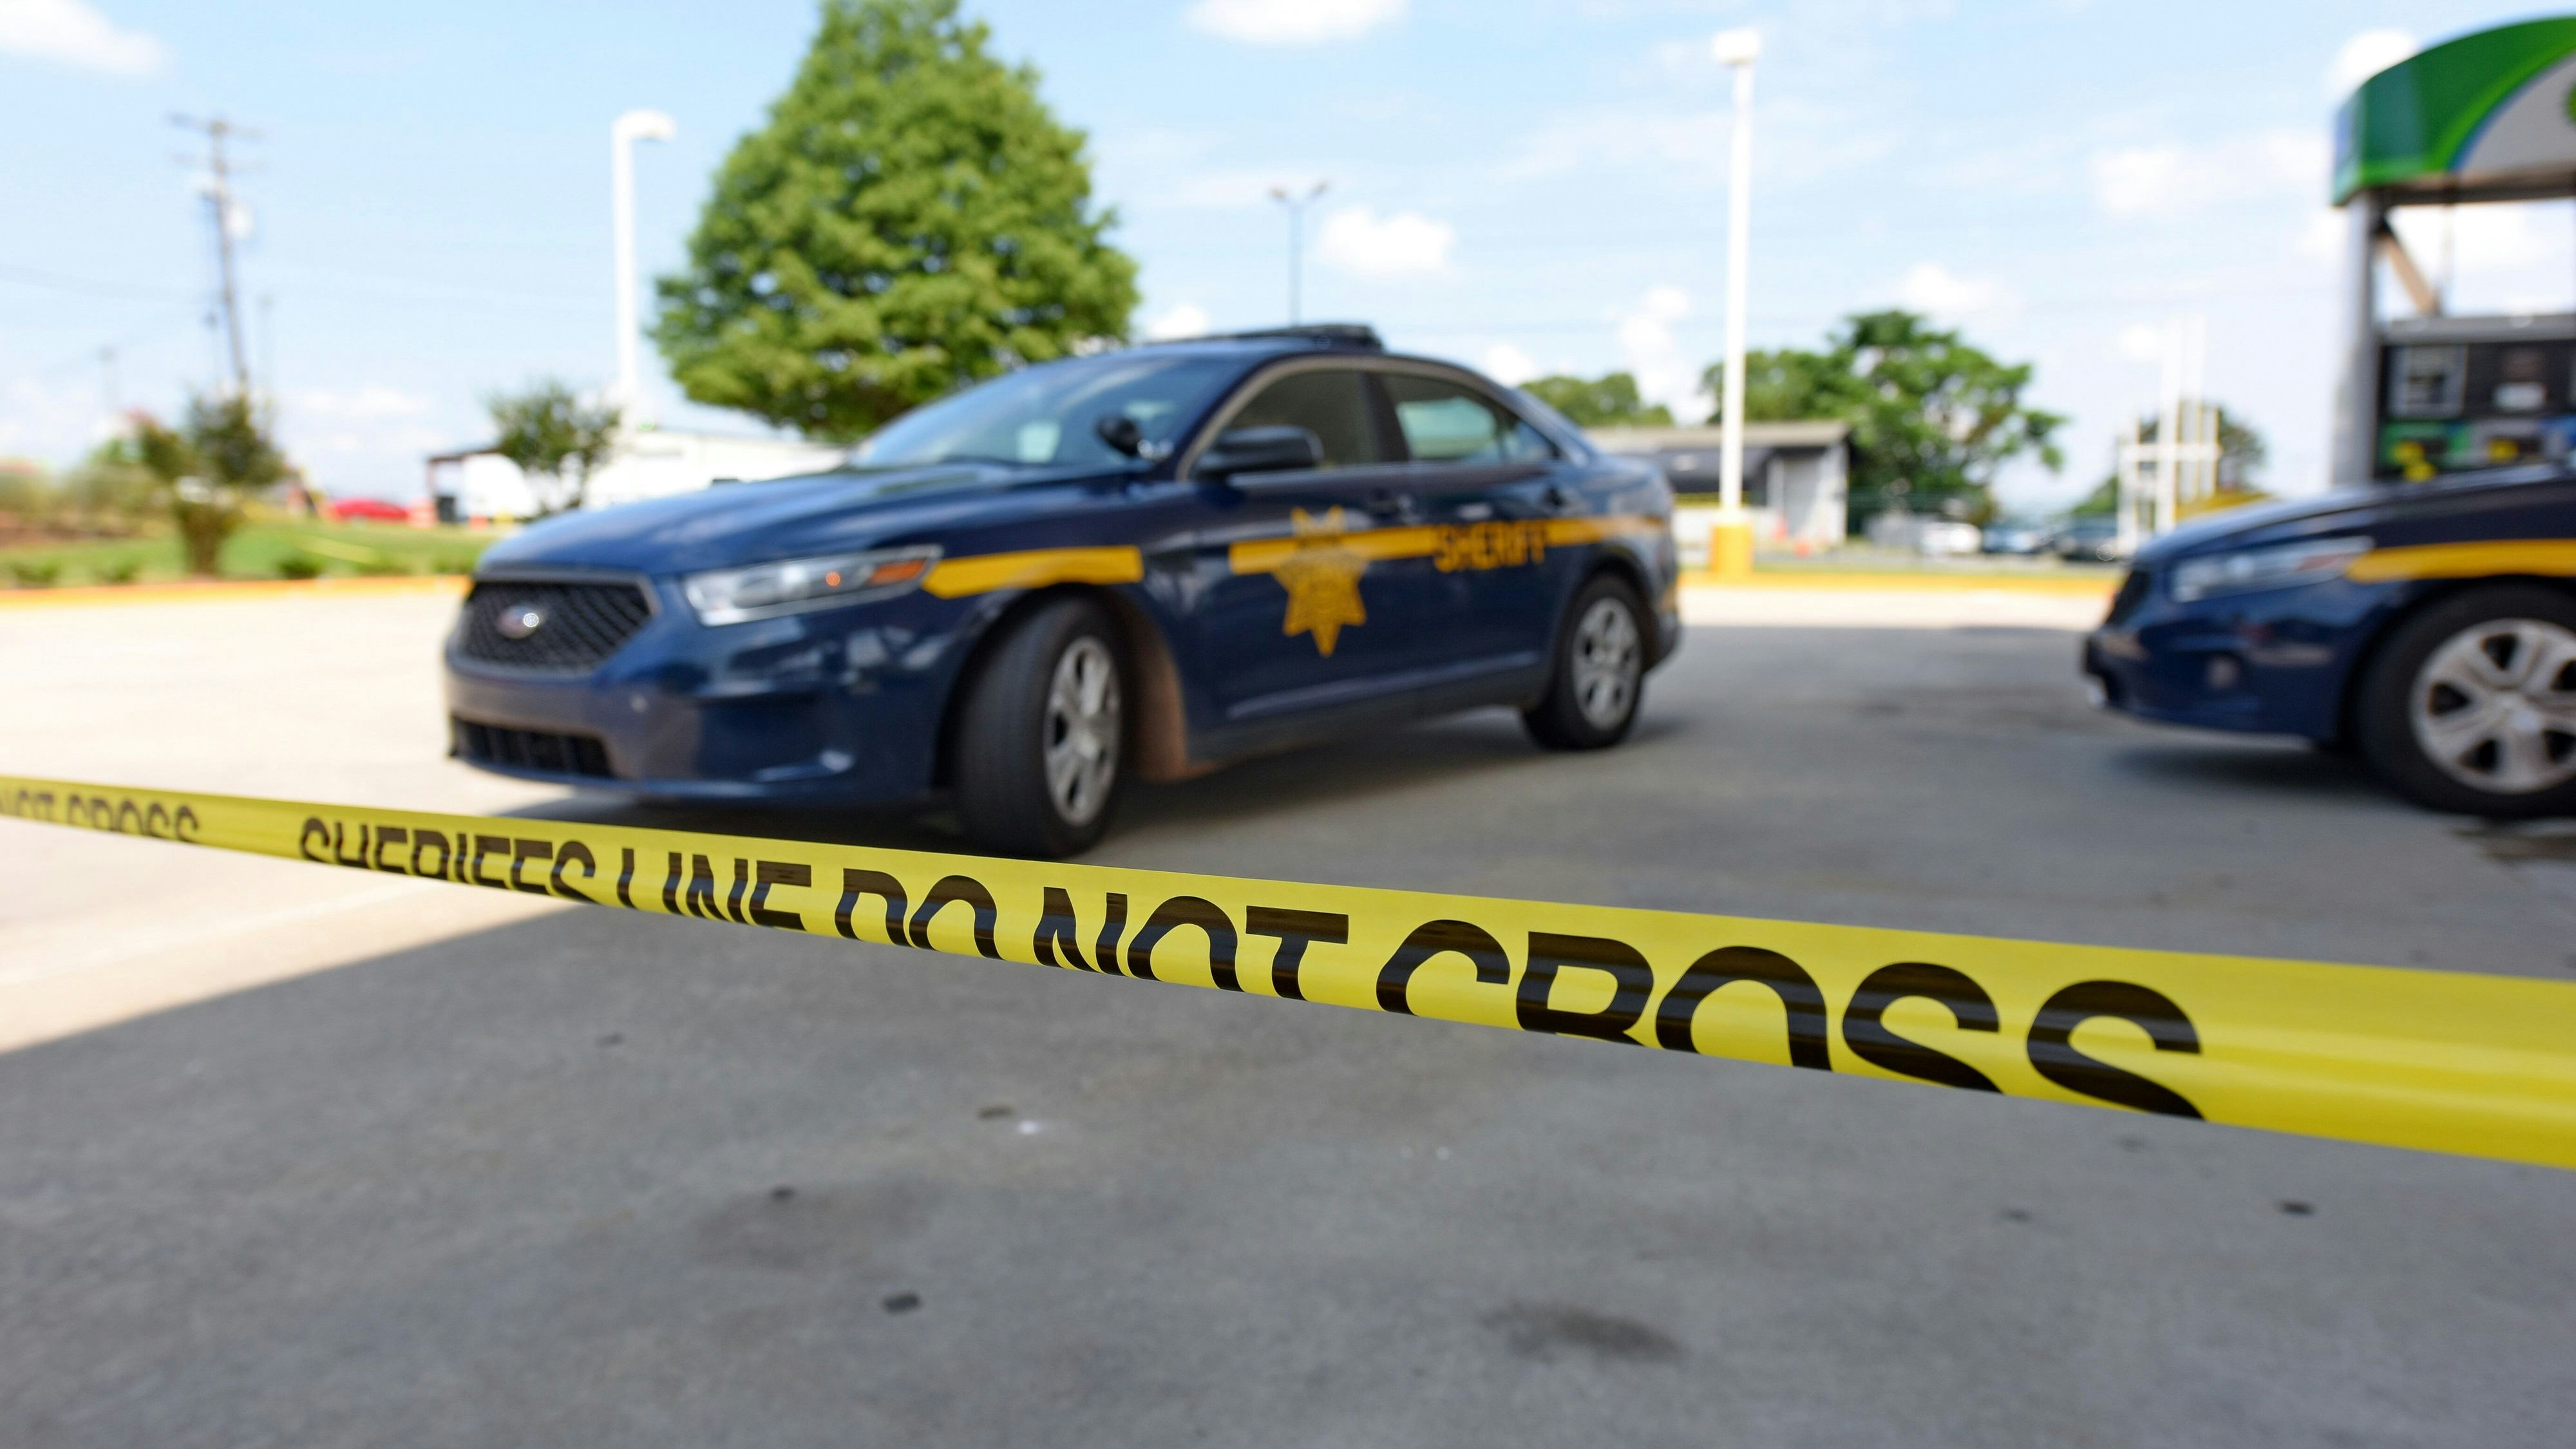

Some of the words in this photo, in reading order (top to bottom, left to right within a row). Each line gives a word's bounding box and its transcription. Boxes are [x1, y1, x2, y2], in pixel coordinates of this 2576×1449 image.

[1434, 522, 1546, 573] SHERIFF
[1, 787, 55, 824] OT
[835, 867, 1006, 961] DO
[1032, 886, 1349, 1001] NOT
[1376, 919, 2206, 1122] CROSS
